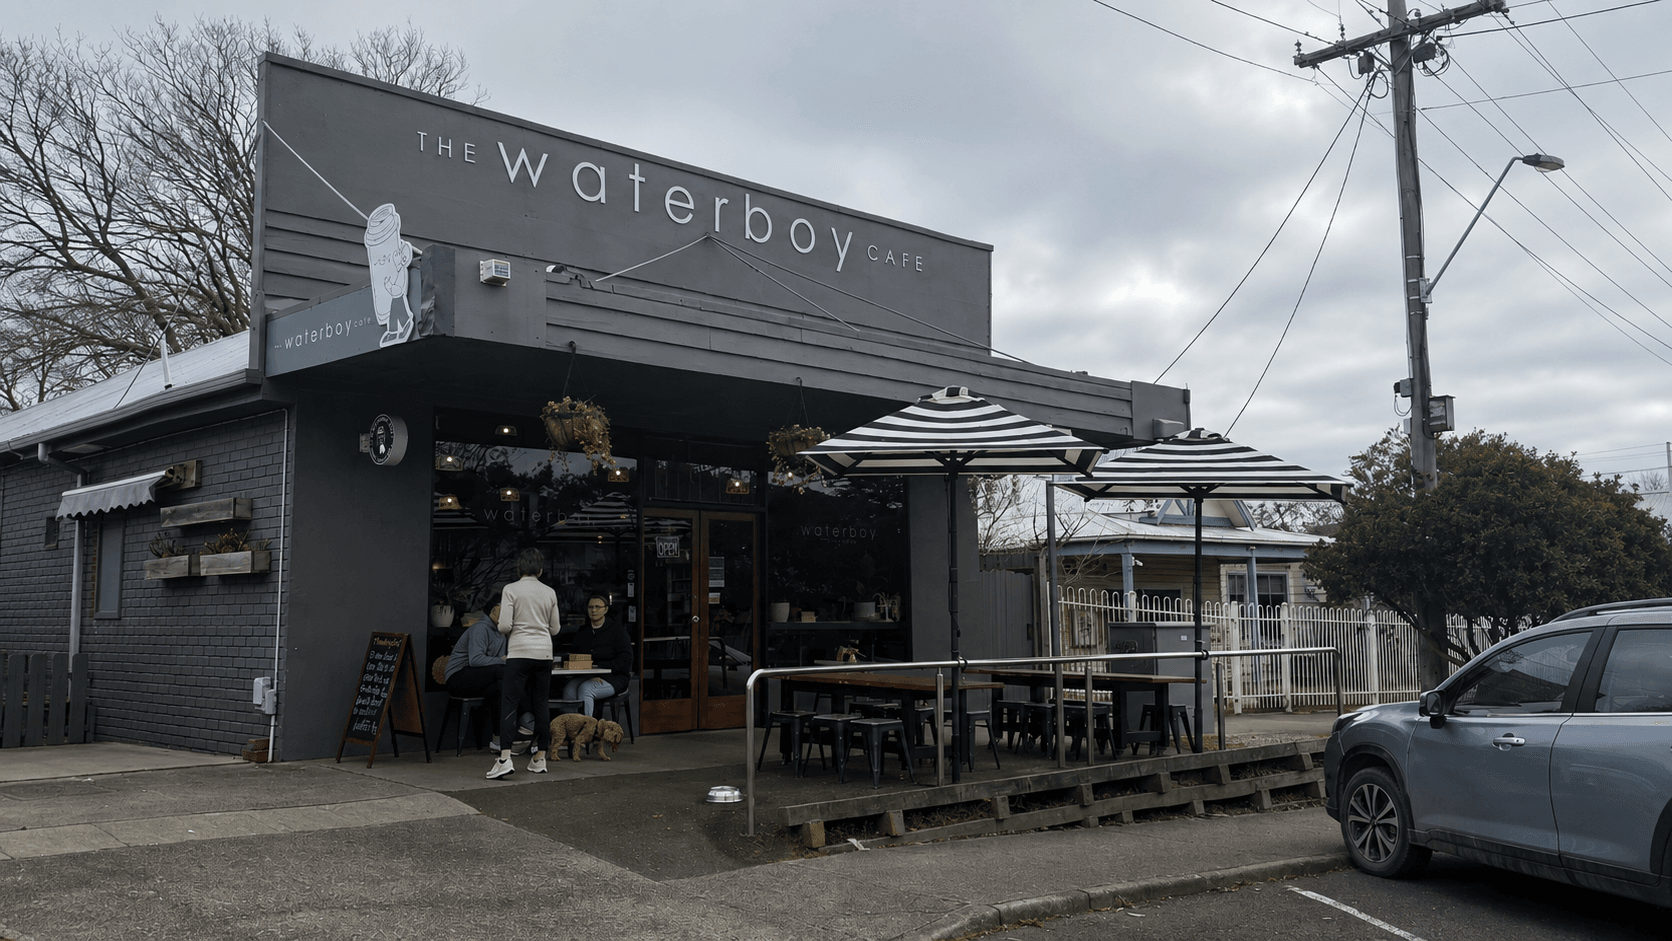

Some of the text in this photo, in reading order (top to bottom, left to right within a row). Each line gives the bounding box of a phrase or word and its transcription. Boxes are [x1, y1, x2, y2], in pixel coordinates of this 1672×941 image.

[417, 131, 923, 272] THE waterboy CAFE
[284, 319, 352, 350] waterboy
[799, 523, 877, 541] waterboy
[658, 541, 678, 556] OPEN
